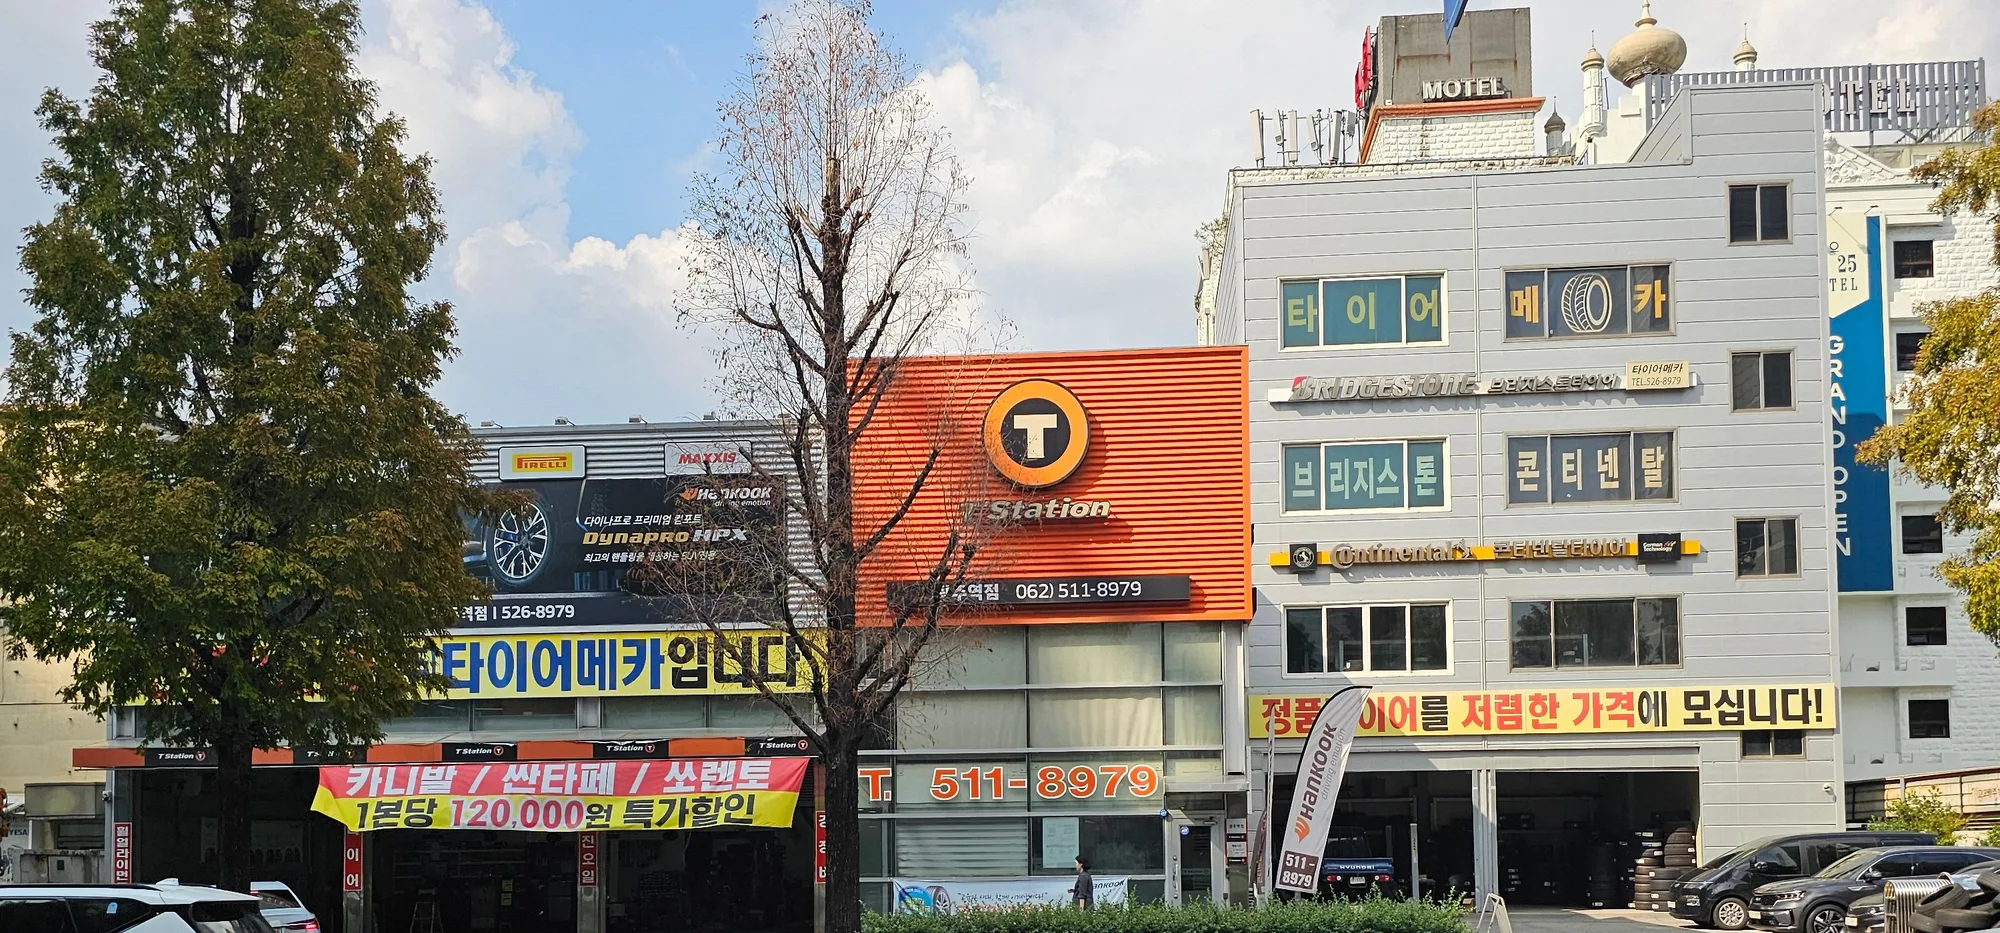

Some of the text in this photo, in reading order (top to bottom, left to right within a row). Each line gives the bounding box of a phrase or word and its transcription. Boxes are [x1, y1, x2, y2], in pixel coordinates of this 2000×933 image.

[1422, 77, 1505, 99] MOTEL
[1837, 254, 1857, 273] 25
[1631, 362, 1683, 374] 타이어메카
[1289, 372, 1618, 401] BRIDGESTONE 브리지스톤타이어
[1829, 335, 1846, 449] GRAND
[1013, 414, 1058, 459] T
[516, 456, 567, 469] PIRELLI
[678, 452, 737, 465] MAXXIS
[987, 496, 1111, 519] Station
[1834, 466, 1851, 556] OPEN
[583, 515, 632, 527] 다이나프로
[633, 514, 672, 526] 프리미엄
[692, 528, 748, 543] HPX
[583, 552, 611, 563] 최고의
[1329, 541, 1456, 569] Continental
[1493, 538, 1627, 559] 콘티넨탈타이어
[1015, 583, 1054, 600] 062)
[1058, 581, 1142, 599] 511-8979
[501, 604, 575, 620] 526-8979
[1358, 694, 1449, 732] 이어를
[1462, 690, 1560, 731] 저렴한
[1572, 690, 1668, 729] 가격에
[1683, 687, 1823, 727] 모십니다!
[164, 752, 194, 760] Station
[1320, 727, 1347, 801] driving emotion
[345, 765, 457, 797] 카니발
[502, 763, 617, 796] 싼타페
[662, 760, 772, 794] 쏘렌토
[930, 764, 1159, 801] 511-8979
[356, 793, 756, 830] 1본당 120,000원 특가할인
[1281, 870, 1313, 888] 8979
